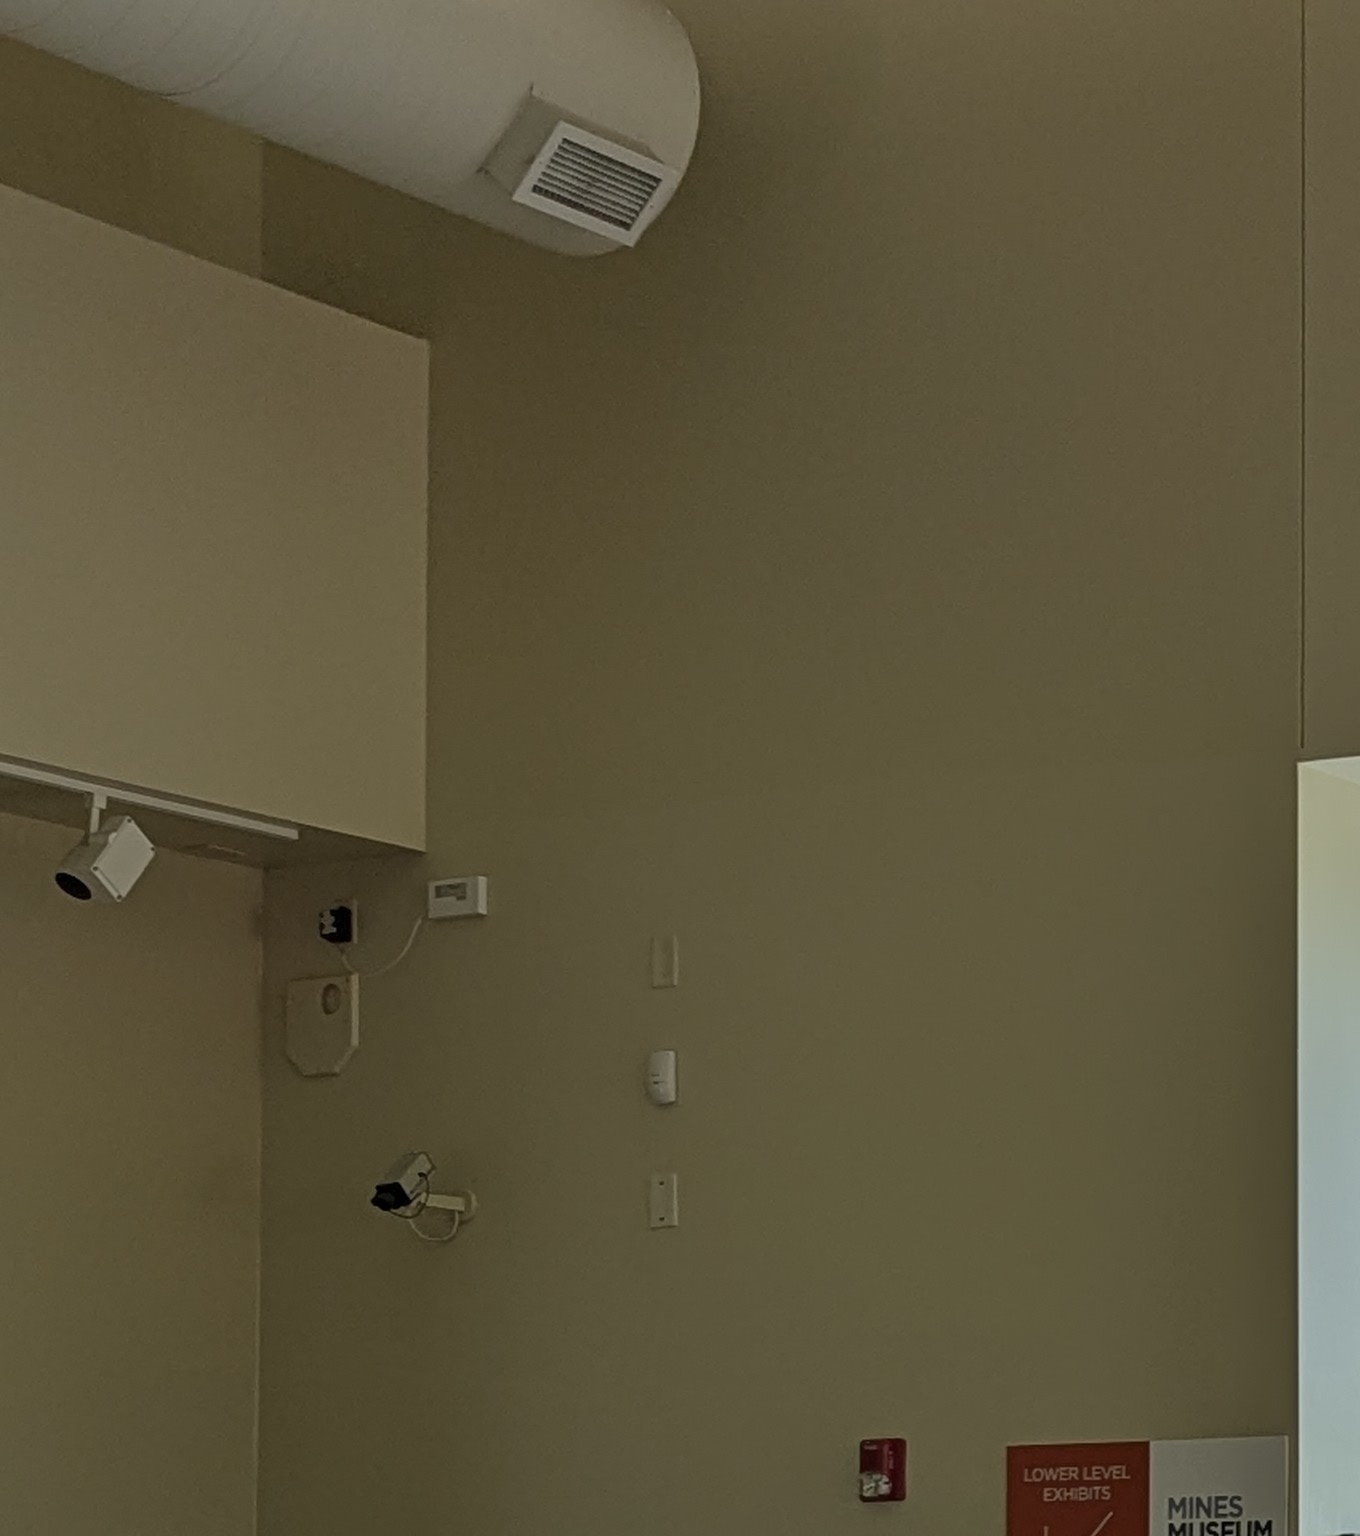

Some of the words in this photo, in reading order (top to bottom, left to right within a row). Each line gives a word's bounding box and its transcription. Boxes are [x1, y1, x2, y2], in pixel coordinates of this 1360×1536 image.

[1023, 1466, 1079, 1483] LOWER
[1083, 1465, 1131, 1481] LEVEL
[1043, 1485, 1112, 1503] EXHIBITS
[1168, 1495, 1243, 1520] MINES
